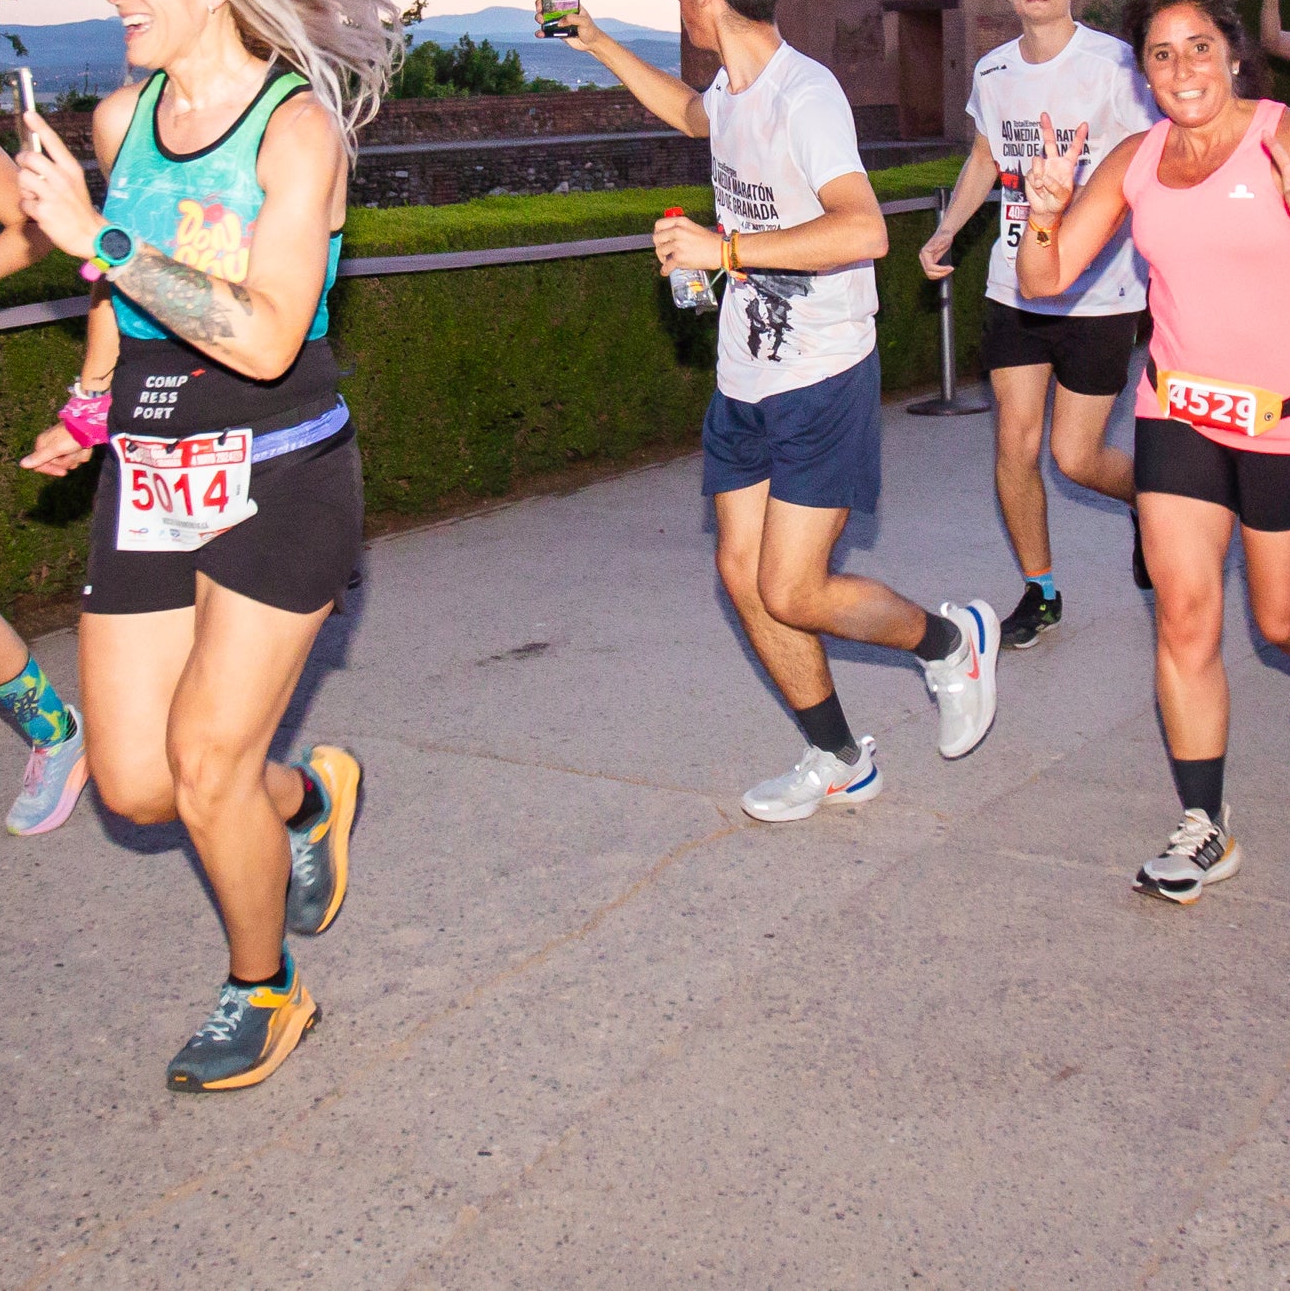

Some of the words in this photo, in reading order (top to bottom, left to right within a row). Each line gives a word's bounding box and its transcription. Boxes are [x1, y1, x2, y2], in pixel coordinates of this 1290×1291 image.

[1002, 121, 1013, 142] 40
[1014, 129, 1040, 142] MEDIA
[1027, 144, 1040, 158] DE
[732, 177, 775, 203] MARATÓN
[732, 196, 780, 221] GRANADA
[145, 375, 189, 388] COMP
[139, 391, 179, 404] RESS
[1169, 384, 1250, 428] 4529
[132, 406, 175, 419] PORT
[131, 469, 230, 516] 5014
